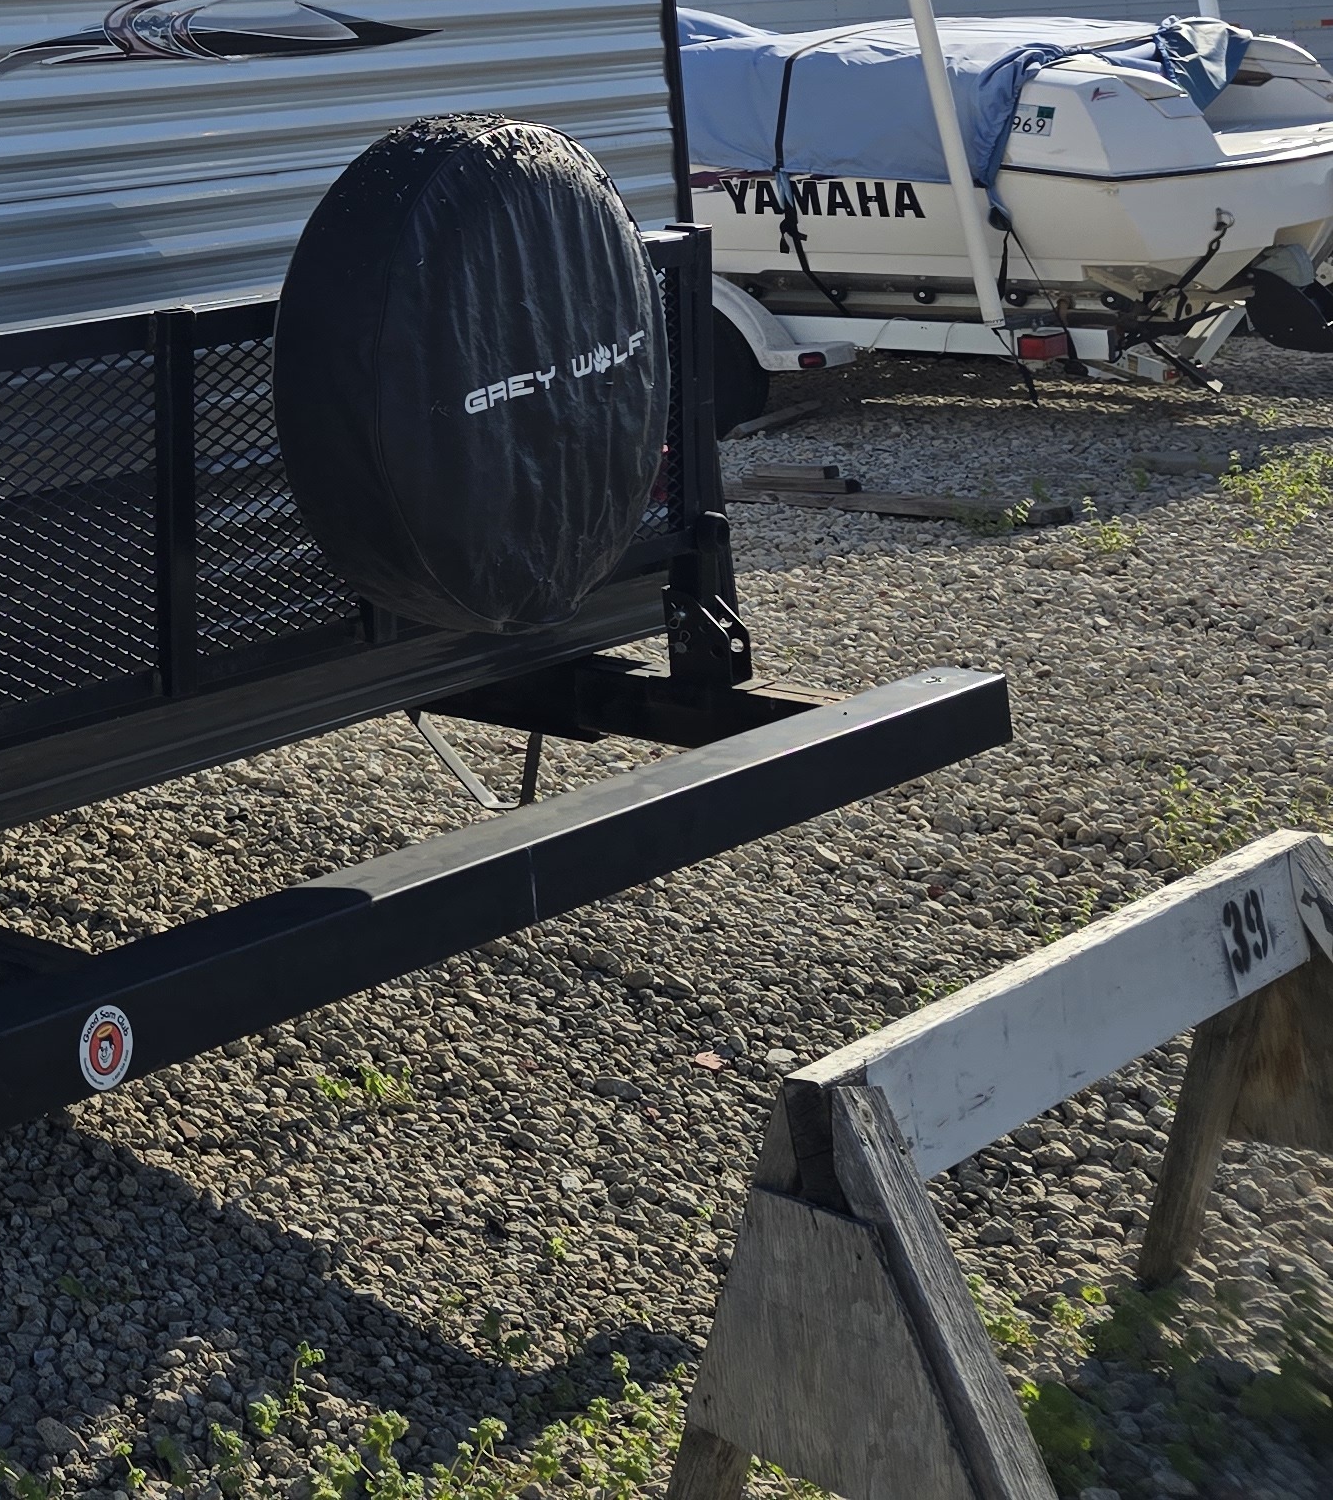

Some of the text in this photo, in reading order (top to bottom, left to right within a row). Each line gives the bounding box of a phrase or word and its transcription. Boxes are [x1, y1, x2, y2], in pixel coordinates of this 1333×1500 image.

[720, 179, 926, 218] YAMAHA
[464, 366, 556, 414] GREY
[83, 1009, 129, 1043] Good Sam Club
